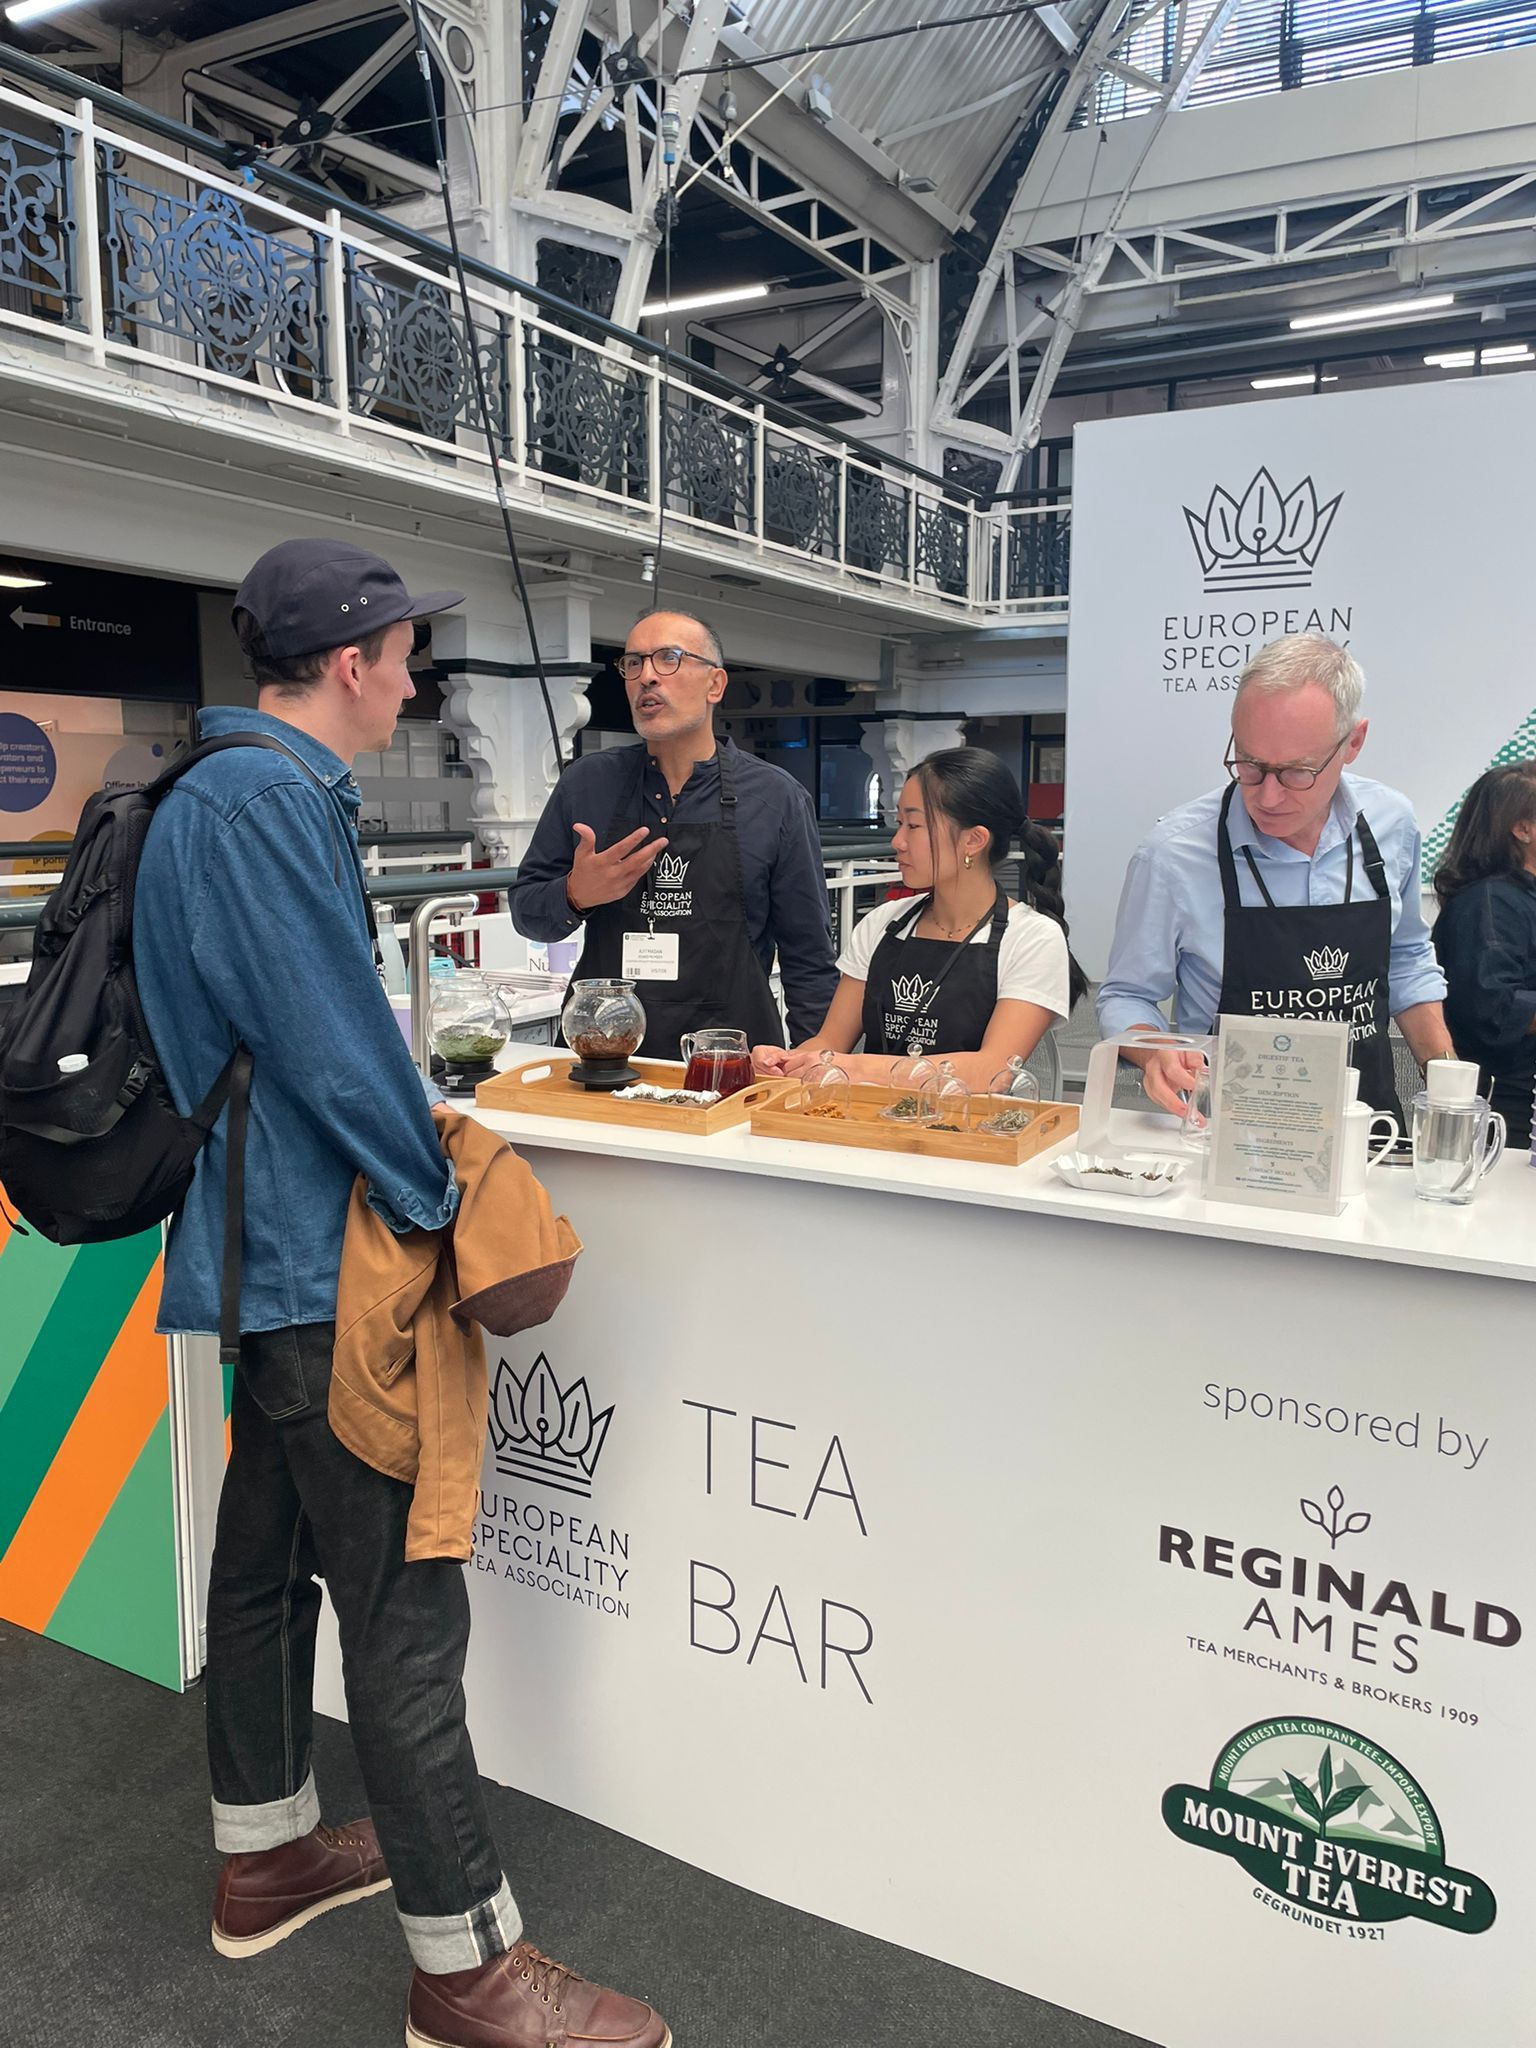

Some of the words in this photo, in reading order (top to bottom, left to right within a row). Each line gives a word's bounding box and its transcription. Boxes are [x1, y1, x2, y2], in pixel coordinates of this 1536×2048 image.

[69, 615, 132, 636] Entrance
[1164, 606, 1353, 641] EUROPEAN
[1163, 676, 1198, 694] TEA
[8, 776, 28, 785] their
[29, 776, 50, 785] work
[37, 766, 47, 774] to
[1250, 977, 1379, 1011] EUROPEAN
[885, 1023, 937, 1038] SPECALITY
[1202, 1381, 1421, 1449] sponsored
[1437, 1416, 1490, 1471] by
[682, 1398, 868, 1537] TEA
[480, 1489, 631, 1561] UROPEAN
[503, 1564, 631, 1620] ASSOCIATION
[1158, 1524, 1523, 1649] REGINALD
[689, 1558, 875, 1705] BAR
[1242, 1596, 1420, 1675] AMES
[1186, 1635, 1218, 1655] TEA
[1223, 1646, 1329, 1686] MERCHANTS
[1333, 1677, 1346, 1692] &
[1351, 1681, 1433, 1715] BROKERS
[1440, 1705, 1480, 1727] 1909
[1217, 1747, 1241, 1782] MOUNT
[1236, 1724, 1277, 1757] EVEREST
[1277, 1721, 1299, 1734] TEA
[1301, 1722, 1358, 1748] COMPANY
[1182, 1796, 1303, 1860] MOUNT
[1313, 1837, 1472, 1915] EVEREST
[1252, 1886, 1343, 1936] GEGRUNDET
[1347, 1924, 1386, 1942] 1927
[1281, 1859, 1361, 1918] TEA
